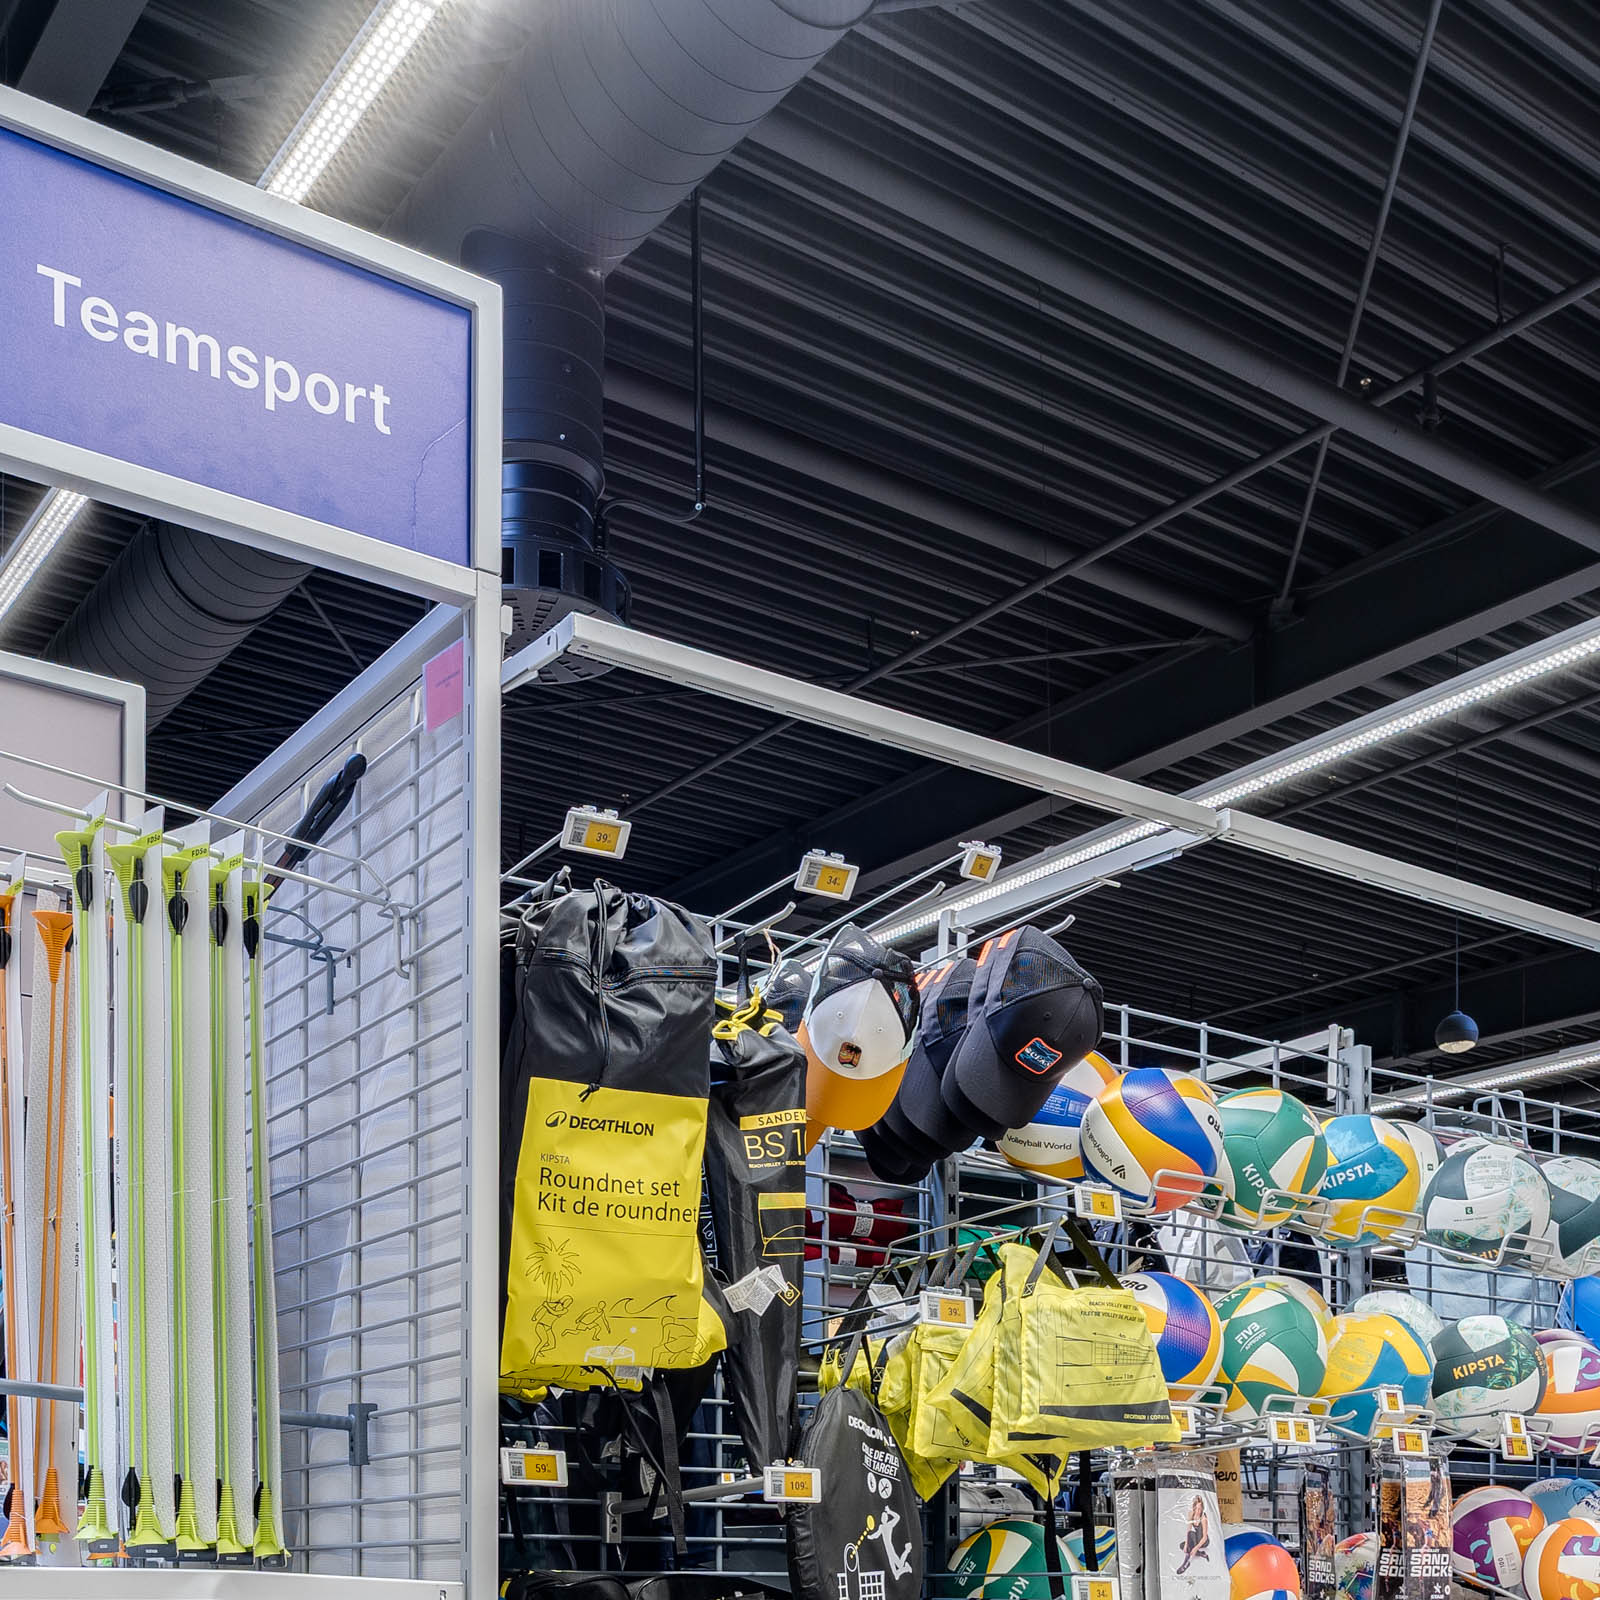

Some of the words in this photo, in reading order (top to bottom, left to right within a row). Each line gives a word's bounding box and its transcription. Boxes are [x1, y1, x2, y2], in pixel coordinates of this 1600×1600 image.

[36, 263, 392, 435] Teamsport
[569, 1115, 655, 1137] DECATHLON
[1207, 1114, 1224, 1140] PRO
[743, 1131, 786, 1160] BS
[791, 1129, 807, 1156] 1
[1006, 1133, 1042, 1149] Volleyball
[1044, 1141, 1072, 1151] World
[540, 1153, 571, 1165] KIPSTA
[539, 1167, 645, 1196] Roundnet
[650, 1179, 681, 1198] set
[1242, 1163, 1279, 1208] KIPSA
[1322, 1161, 1376, 1190] KIPSTA
[537, 1191, 567, 1213] Kit
[573, 1195, 600, 1217] de
[606, 1202, 697, 1223] roundnet
[1452, 1354, 1505, 1380] KIPSTA
[872, 1460, 898, 1477] TARGET
[1308, 1559, 1332, 1571] SAND
[1410, 1553, 1449, 1565] SAND
[1308, 1571, 1335, 1585] SOCKS
[1379, 1566, 1405, 1578] SOC
[1410, 1565, 1453, 1578] SOCKS
